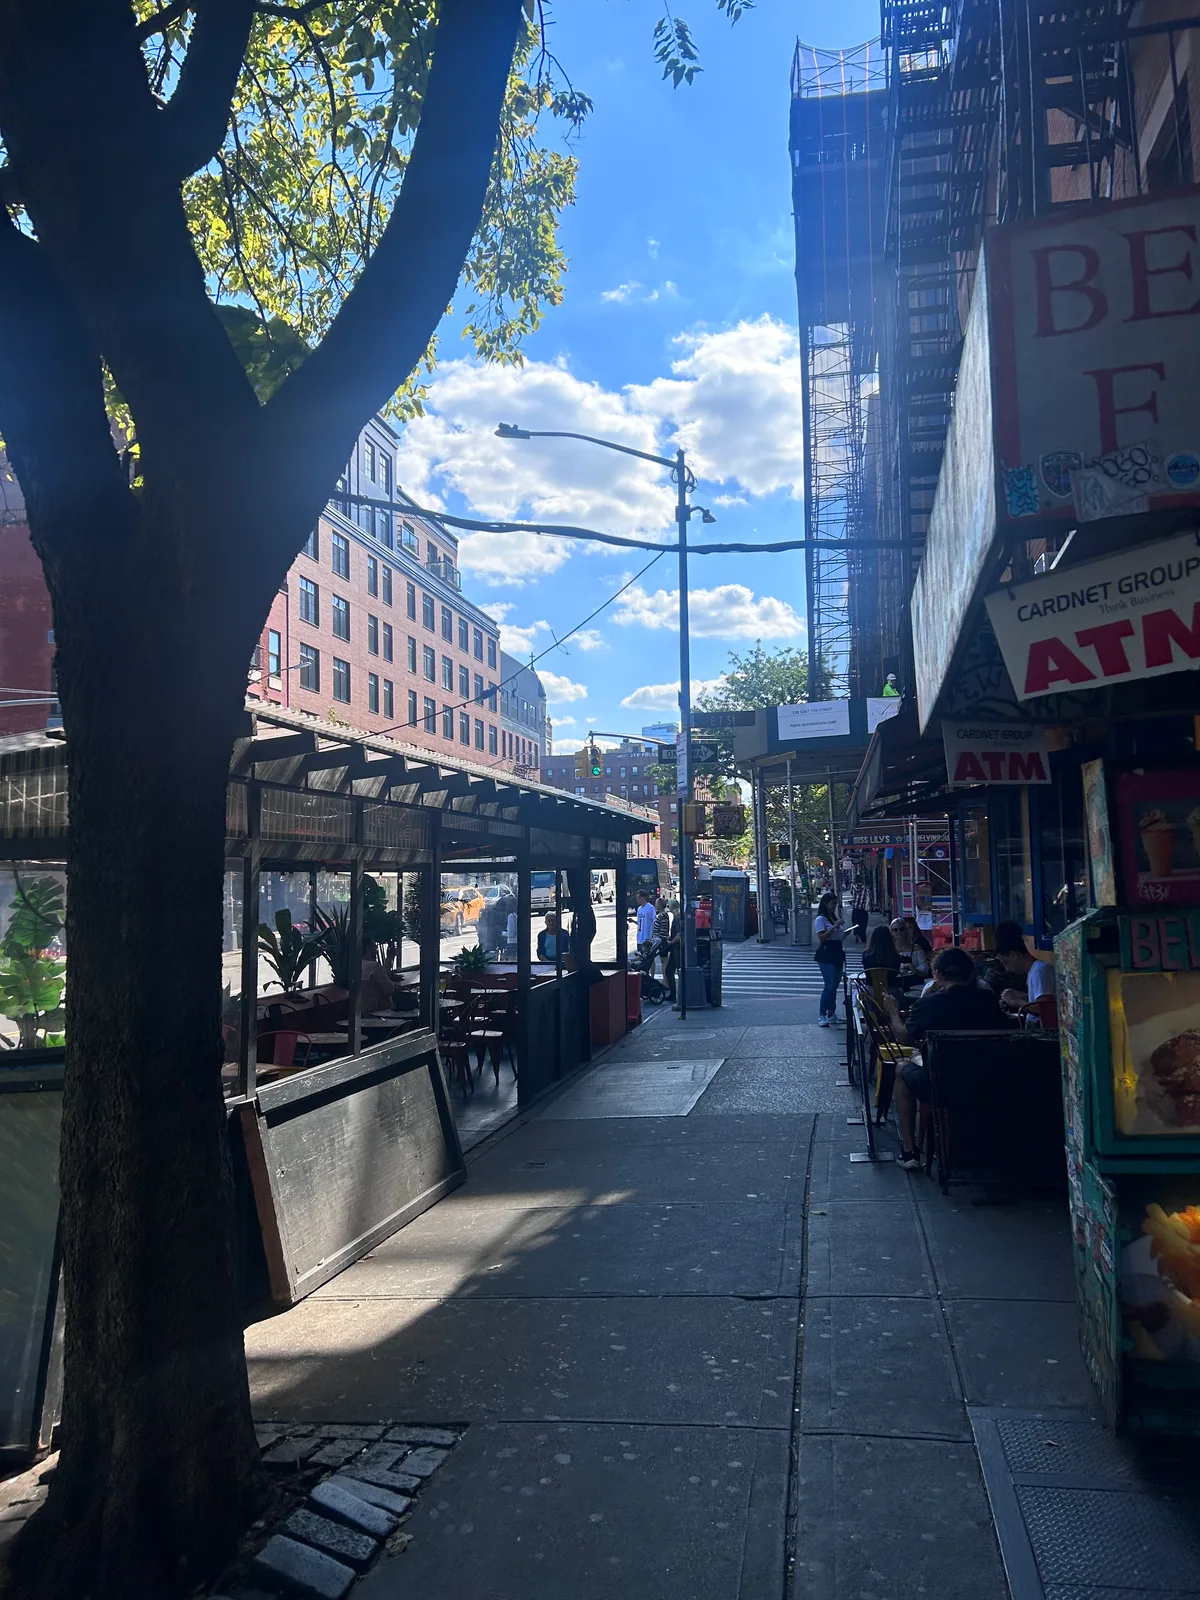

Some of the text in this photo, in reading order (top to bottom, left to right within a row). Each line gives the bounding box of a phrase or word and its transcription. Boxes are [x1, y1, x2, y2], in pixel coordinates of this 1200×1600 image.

[1017, 556, 1200, 622] CARDNET GROUP
[1099, 588, 1175, 615] Think Business
[1024, 601, 1200, 694] ATM
[727, 715, 736, 726] St
[956, 729, 1032, 740] CARDNET GROUP
[953, 751, 1047, 781] ATM
[853, 836, 869, 844] MISS
[870, 835, 891, 844] LILY'S
